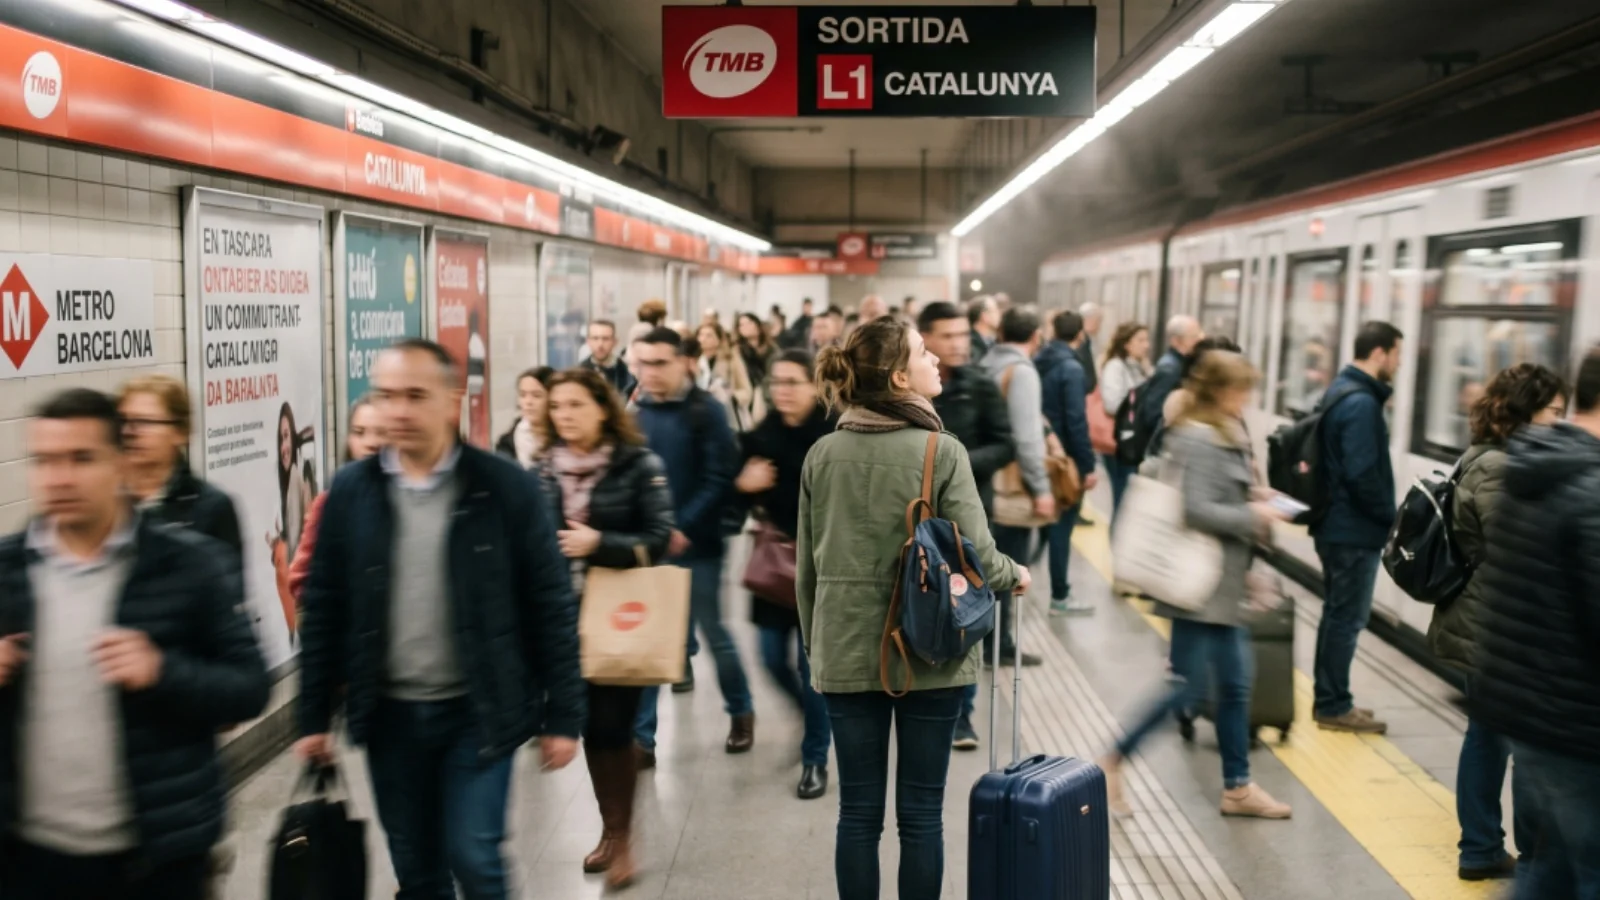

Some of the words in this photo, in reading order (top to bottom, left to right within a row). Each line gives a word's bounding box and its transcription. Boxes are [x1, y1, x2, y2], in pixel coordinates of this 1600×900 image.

[817, 17, 969, 43] SORTIDA
[703, 52, 765, 72] TMB
[31, 74, 57, 96] TMB
[822, 64, 867, 100] L1
[884, 72, 1059, 96] CATALUNYA
[203, 227, 219, 254] EN
[221, 228, 273, 258] TASCARA
[263, 268, 278, 294] AS
[2, 290, 31, 342] M
[56, 289, 115, 321] METRO
[205, 304, 223, 332] UN
[57, 328, 153, 364] BARCELONA
[207, 379, 222, 407] DA
